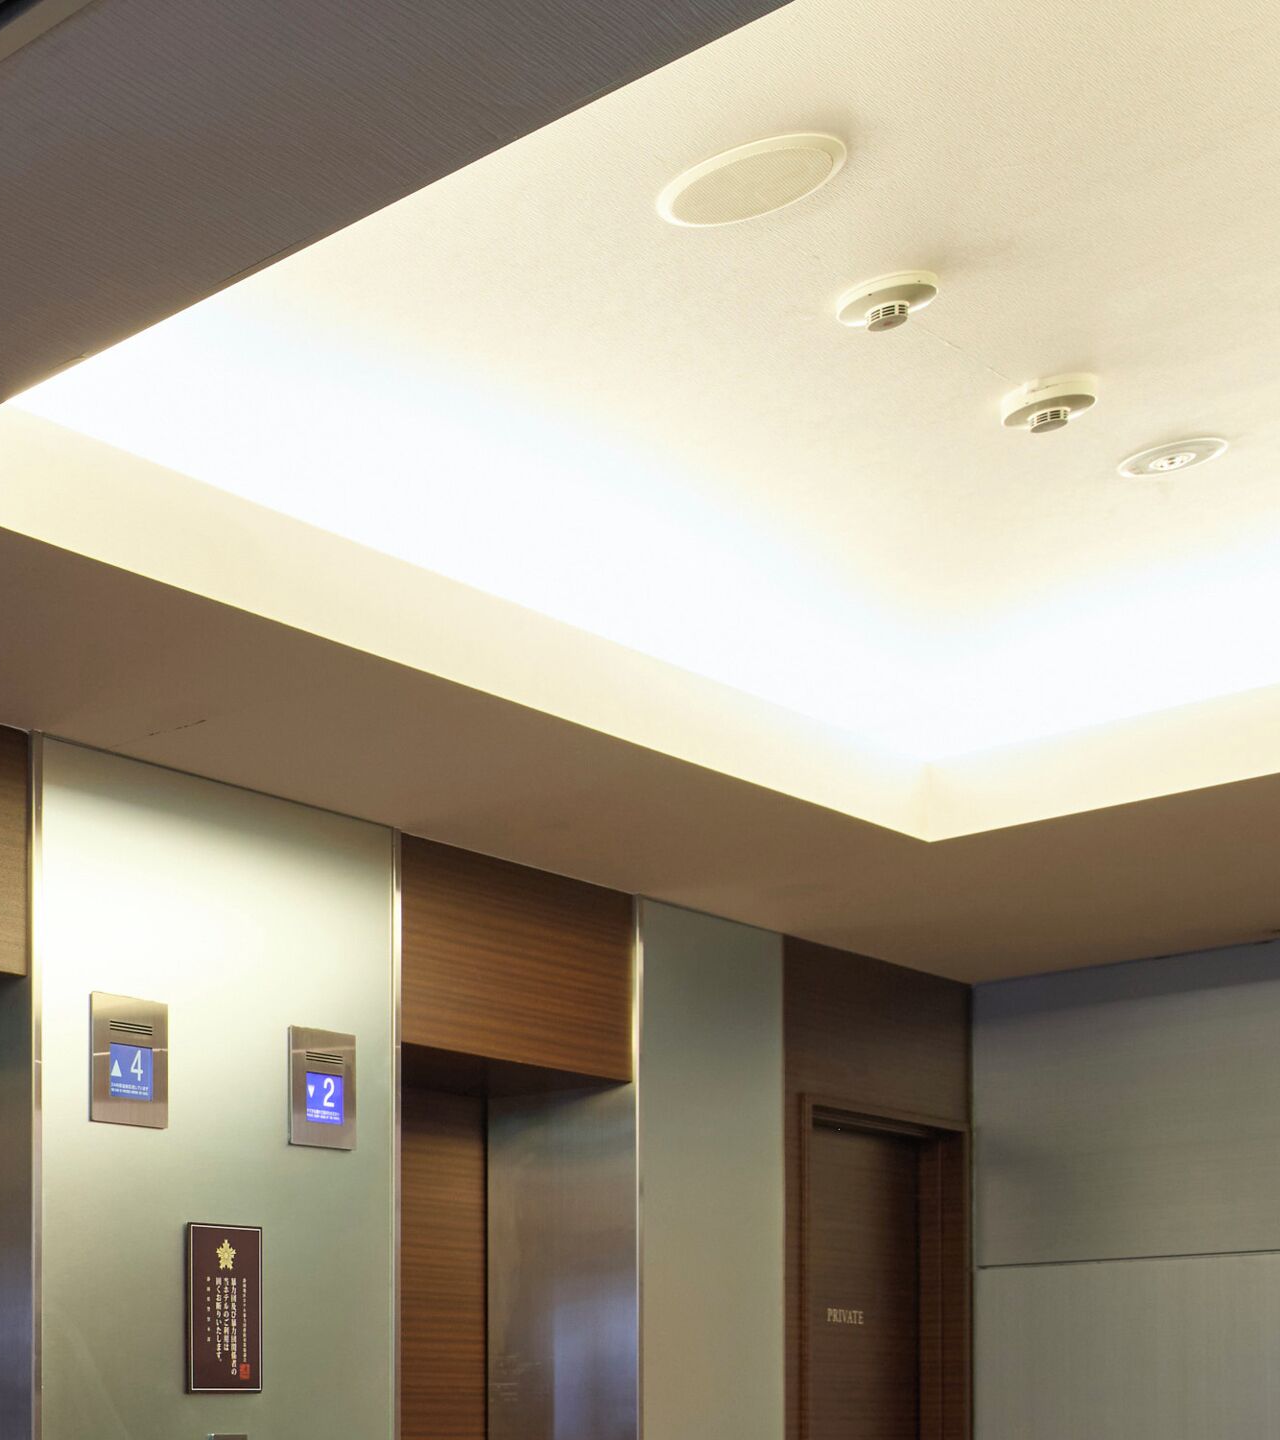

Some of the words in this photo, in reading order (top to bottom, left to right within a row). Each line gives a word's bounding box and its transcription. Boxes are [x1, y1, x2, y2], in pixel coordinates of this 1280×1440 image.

[130, 1049, 144, 1082] 4
[323, 1077, 335, 1108] 2
[826, 1307, 865, 1325] PRIVATE
